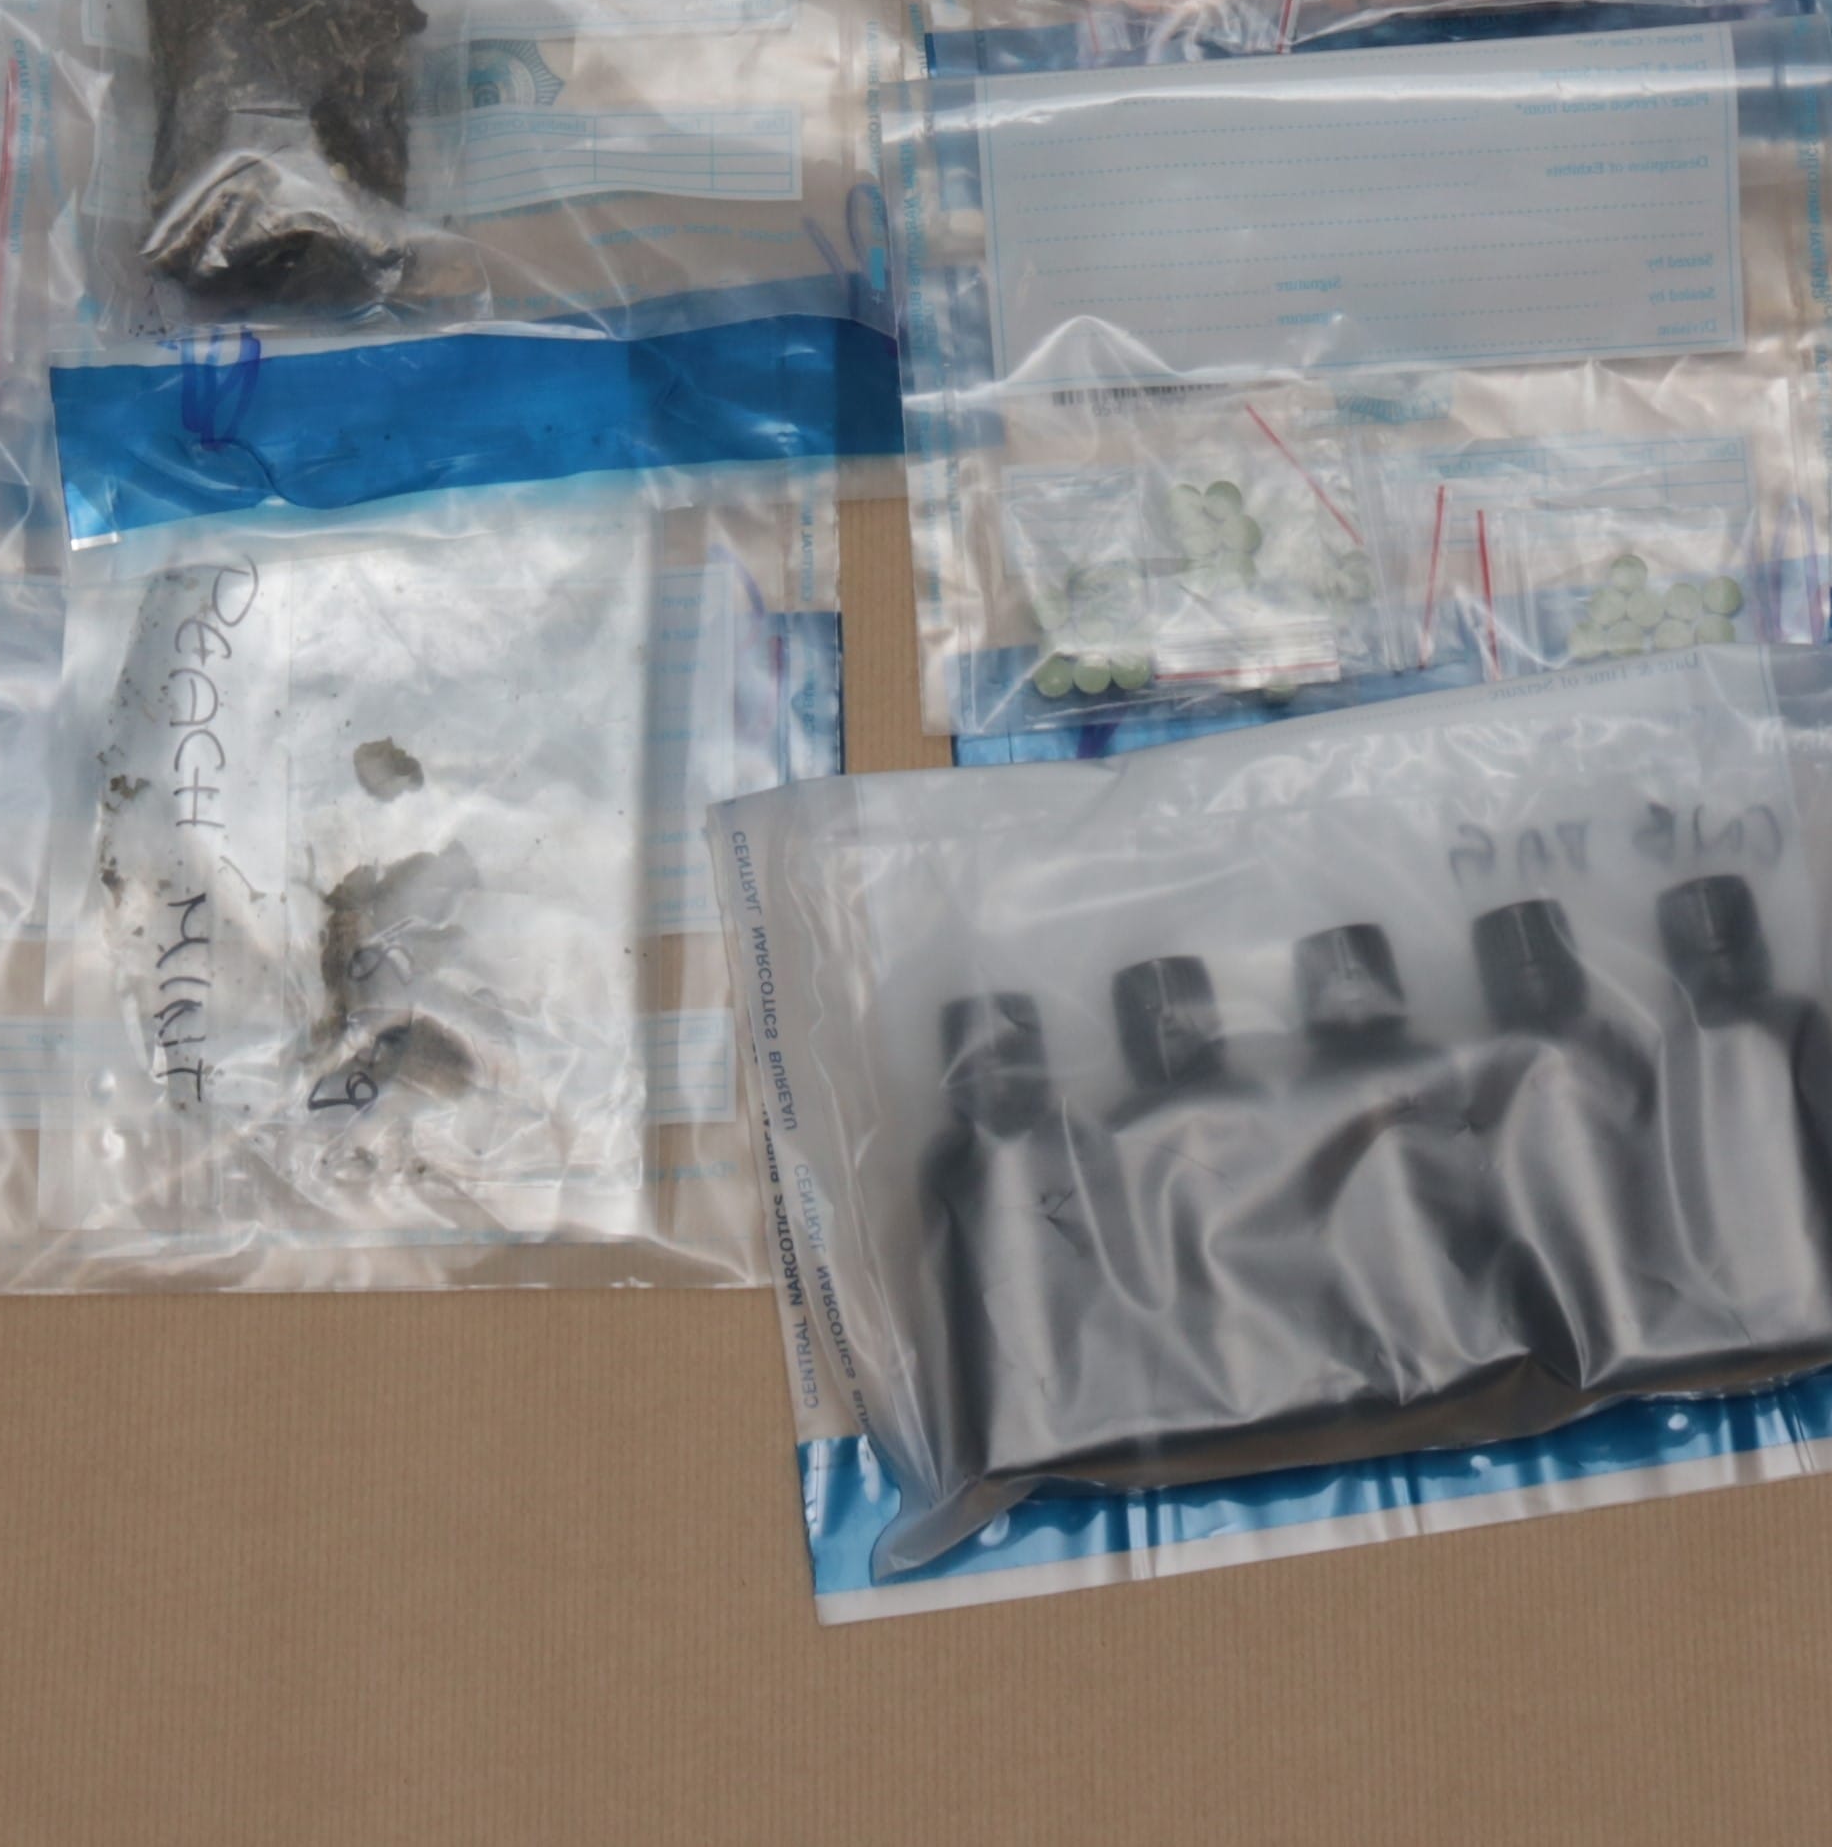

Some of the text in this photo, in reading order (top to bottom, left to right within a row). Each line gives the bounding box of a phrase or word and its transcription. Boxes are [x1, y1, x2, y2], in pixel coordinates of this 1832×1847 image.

[167, 551, 258, 829] PEACH
[772, 1193, 820, 1410] CENTRAL NARCOTICS
